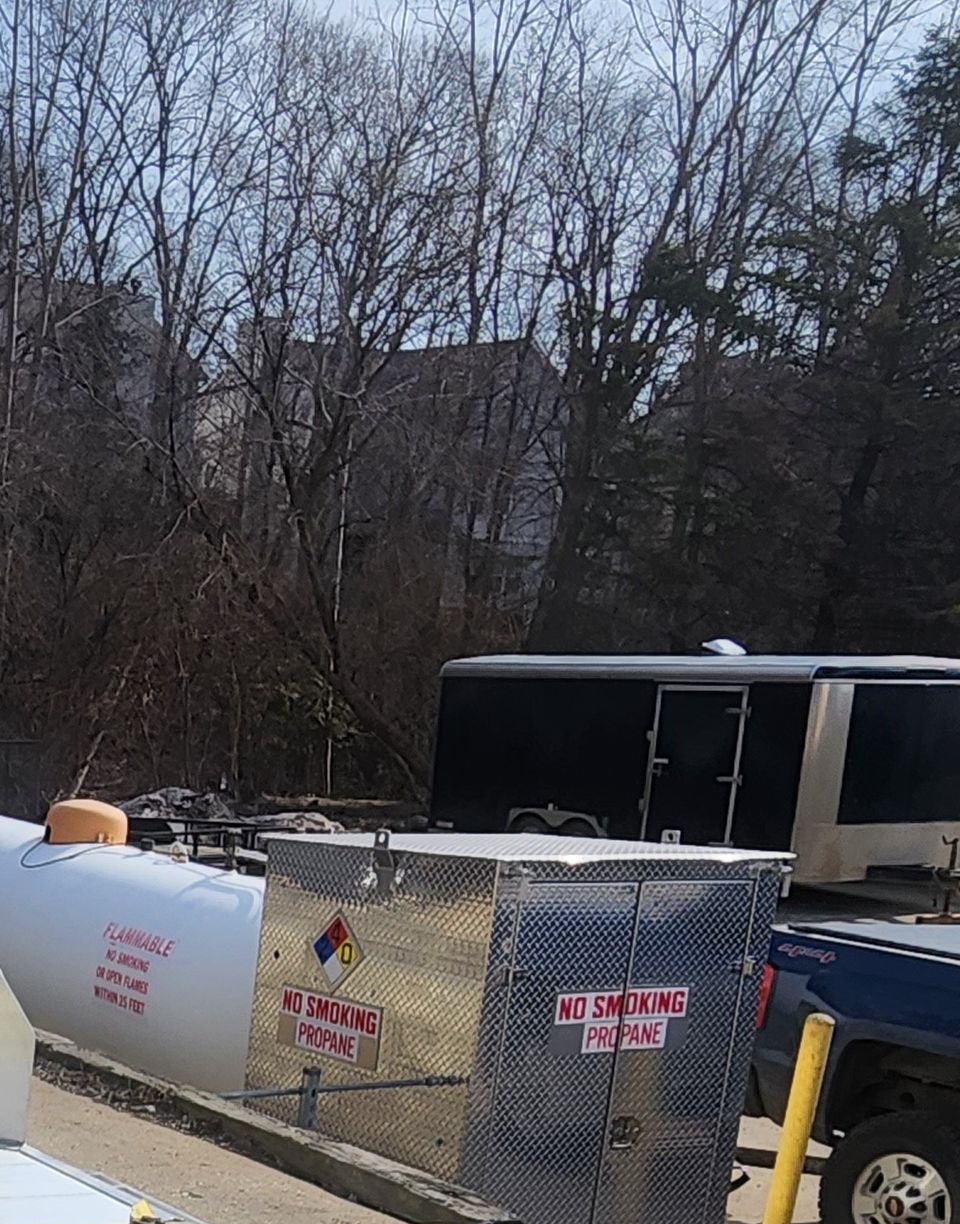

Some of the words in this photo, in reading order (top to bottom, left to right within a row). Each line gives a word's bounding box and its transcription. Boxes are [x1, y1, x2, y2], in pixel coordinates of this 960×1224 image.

[103, 922, 175, 957] FLAMMABLE
[340, 942, 353, 965] 0
[105, 949, 117, 962] NO
[117, 952, 150, 973] SMOKING
[96, 965, 106, 978] OR
[106, 969, 123, 986] OPEN
[123, 975, 149, 995] FLAMES
[94, 985, 118, 1005] WITHIN
[128, 998, 145, 1016] FEET
[283, 989, 303, 1014] NO
[306, 996, 377, 1034] SMOKING
[558, 996, 587, 1021] NO
[592, 991, 686, 1018] SMOKING
[298, 1022, 356, 1058] PROPANE
[586, 1022, 663, 1049] PROPANE
